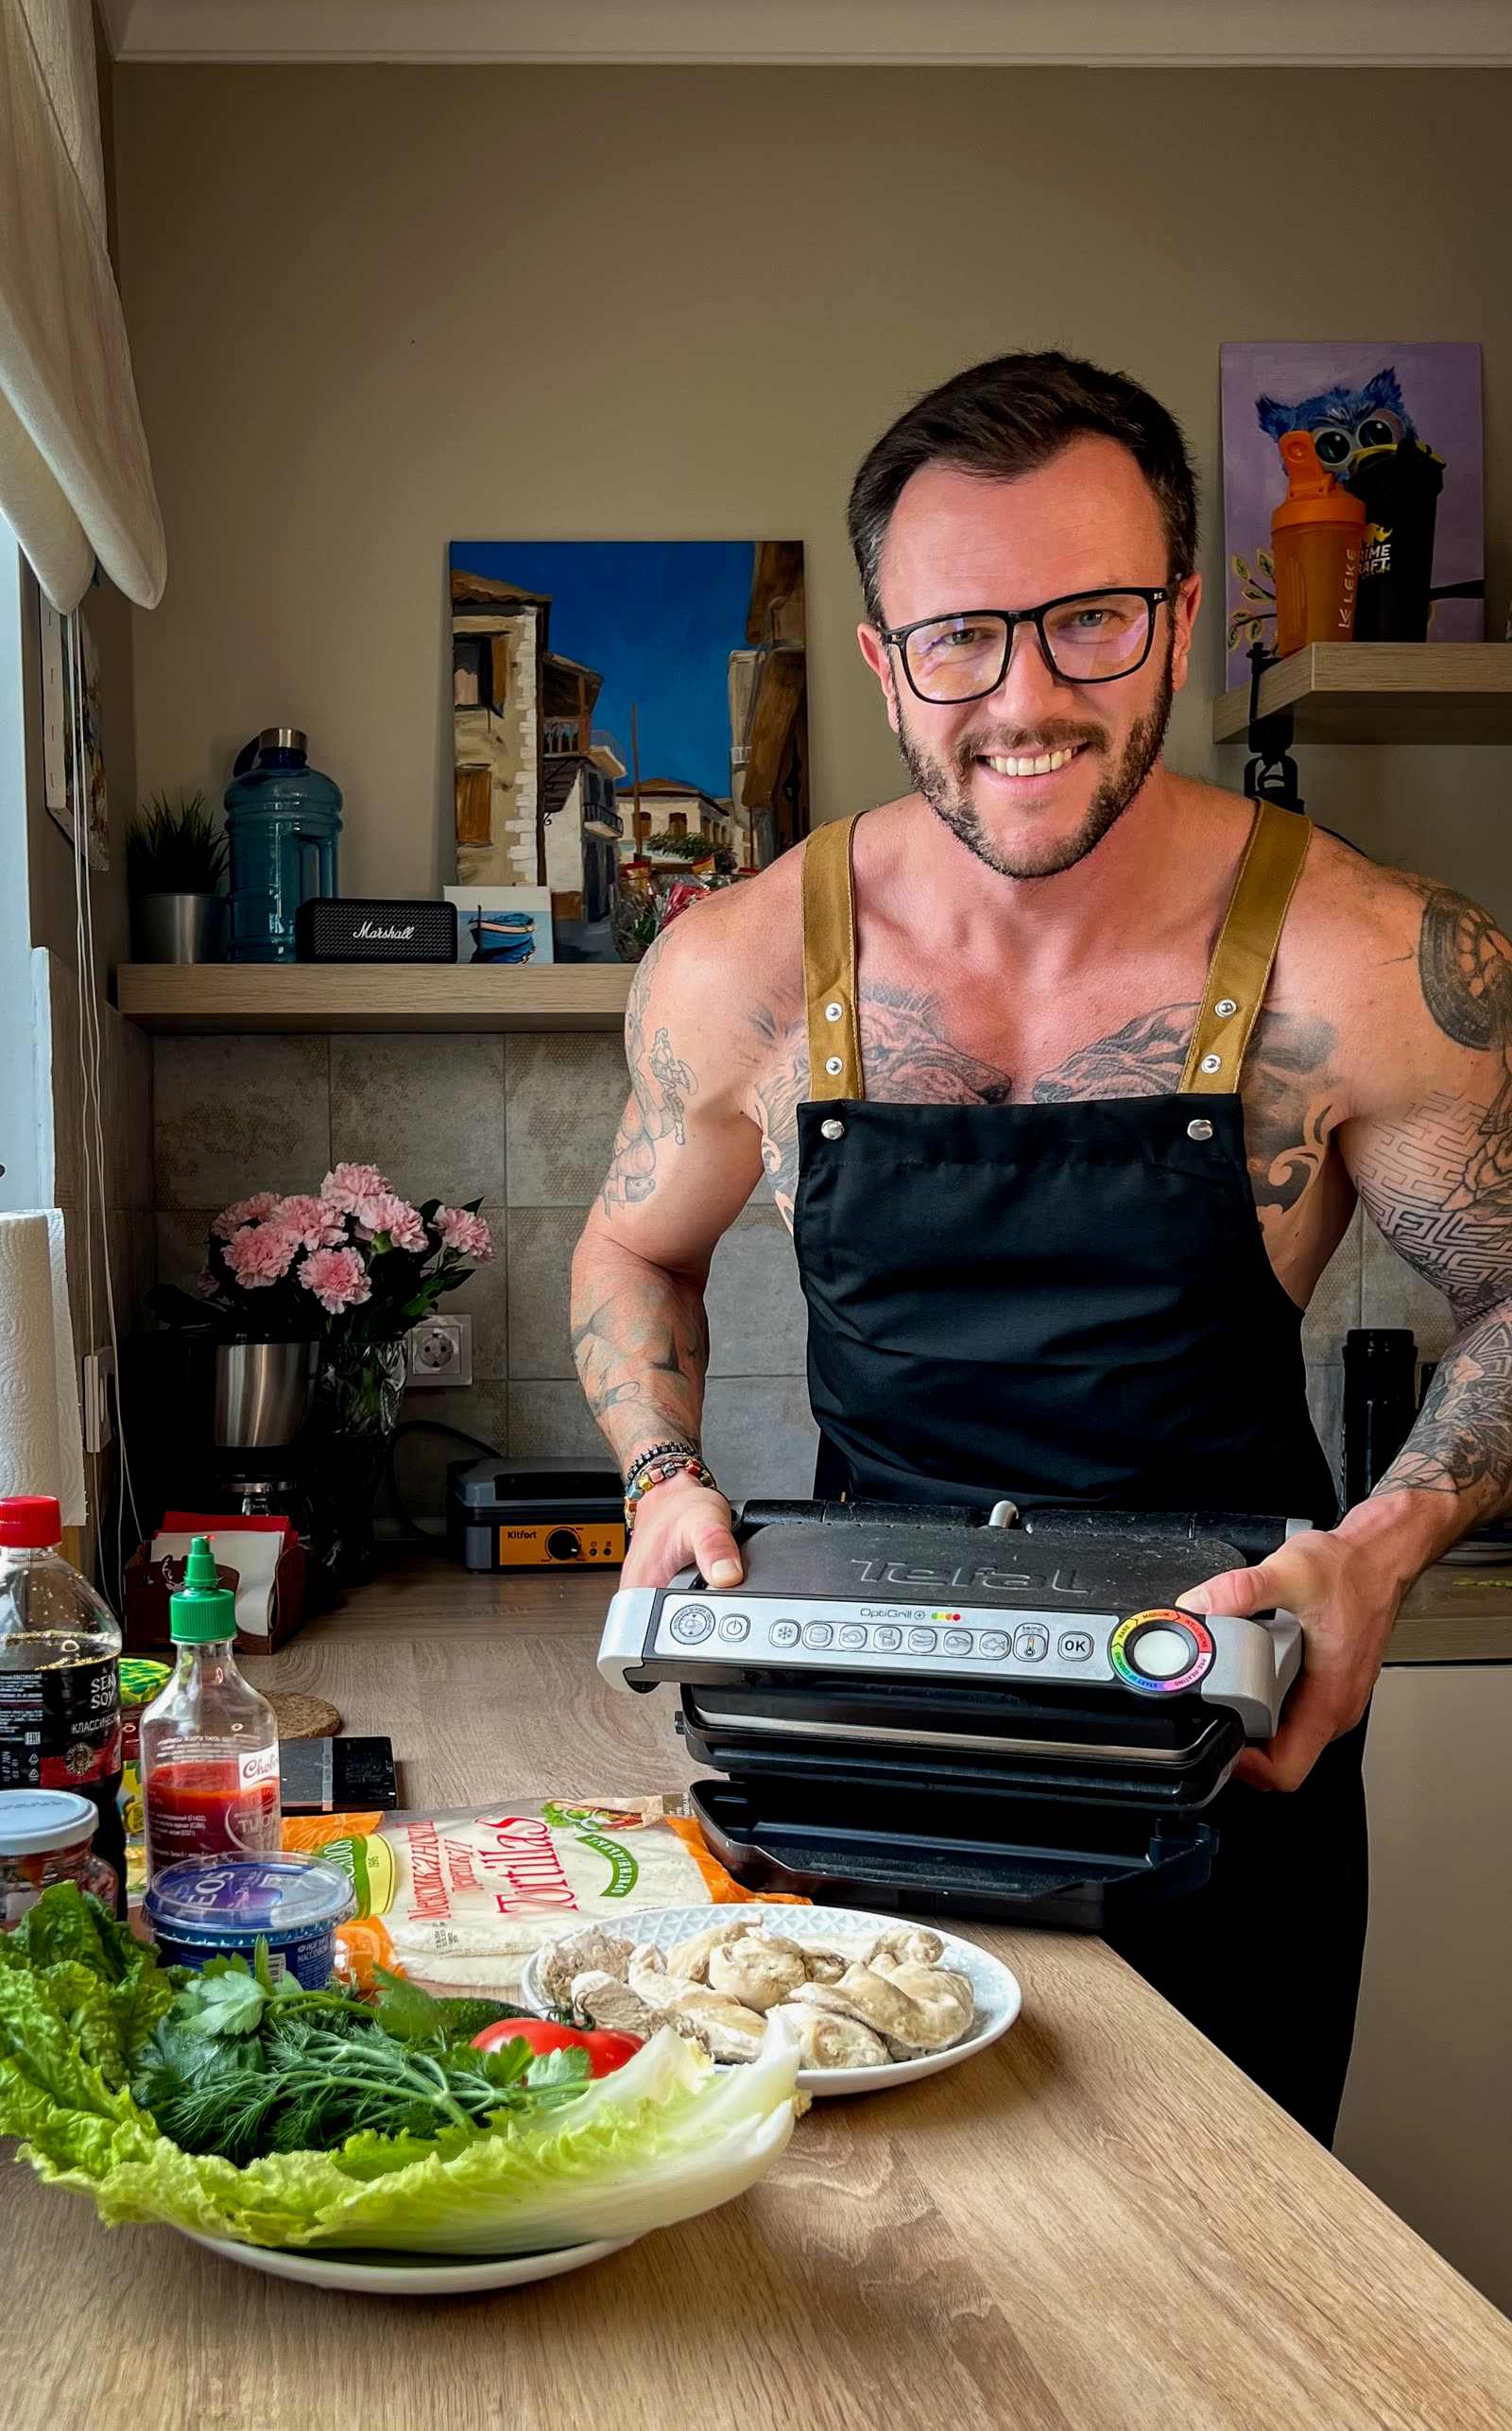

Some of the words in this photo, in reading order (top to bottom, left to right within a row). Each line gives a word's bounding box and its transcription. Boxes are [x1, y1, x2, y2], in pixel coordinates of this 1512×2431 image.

[352, 921, 415, 940] Marshall
[507, 1530, 537, 1539] Kitfort
[850, 1558, 1094, 1595] Tefal
[860, 1608, 912, 1618] OptiGrill
[1065, 1641, 1086, 1652] OK
[91, 1690, 114, 1710] SOY
[474, 1816, 580, 1915] Tortillas
